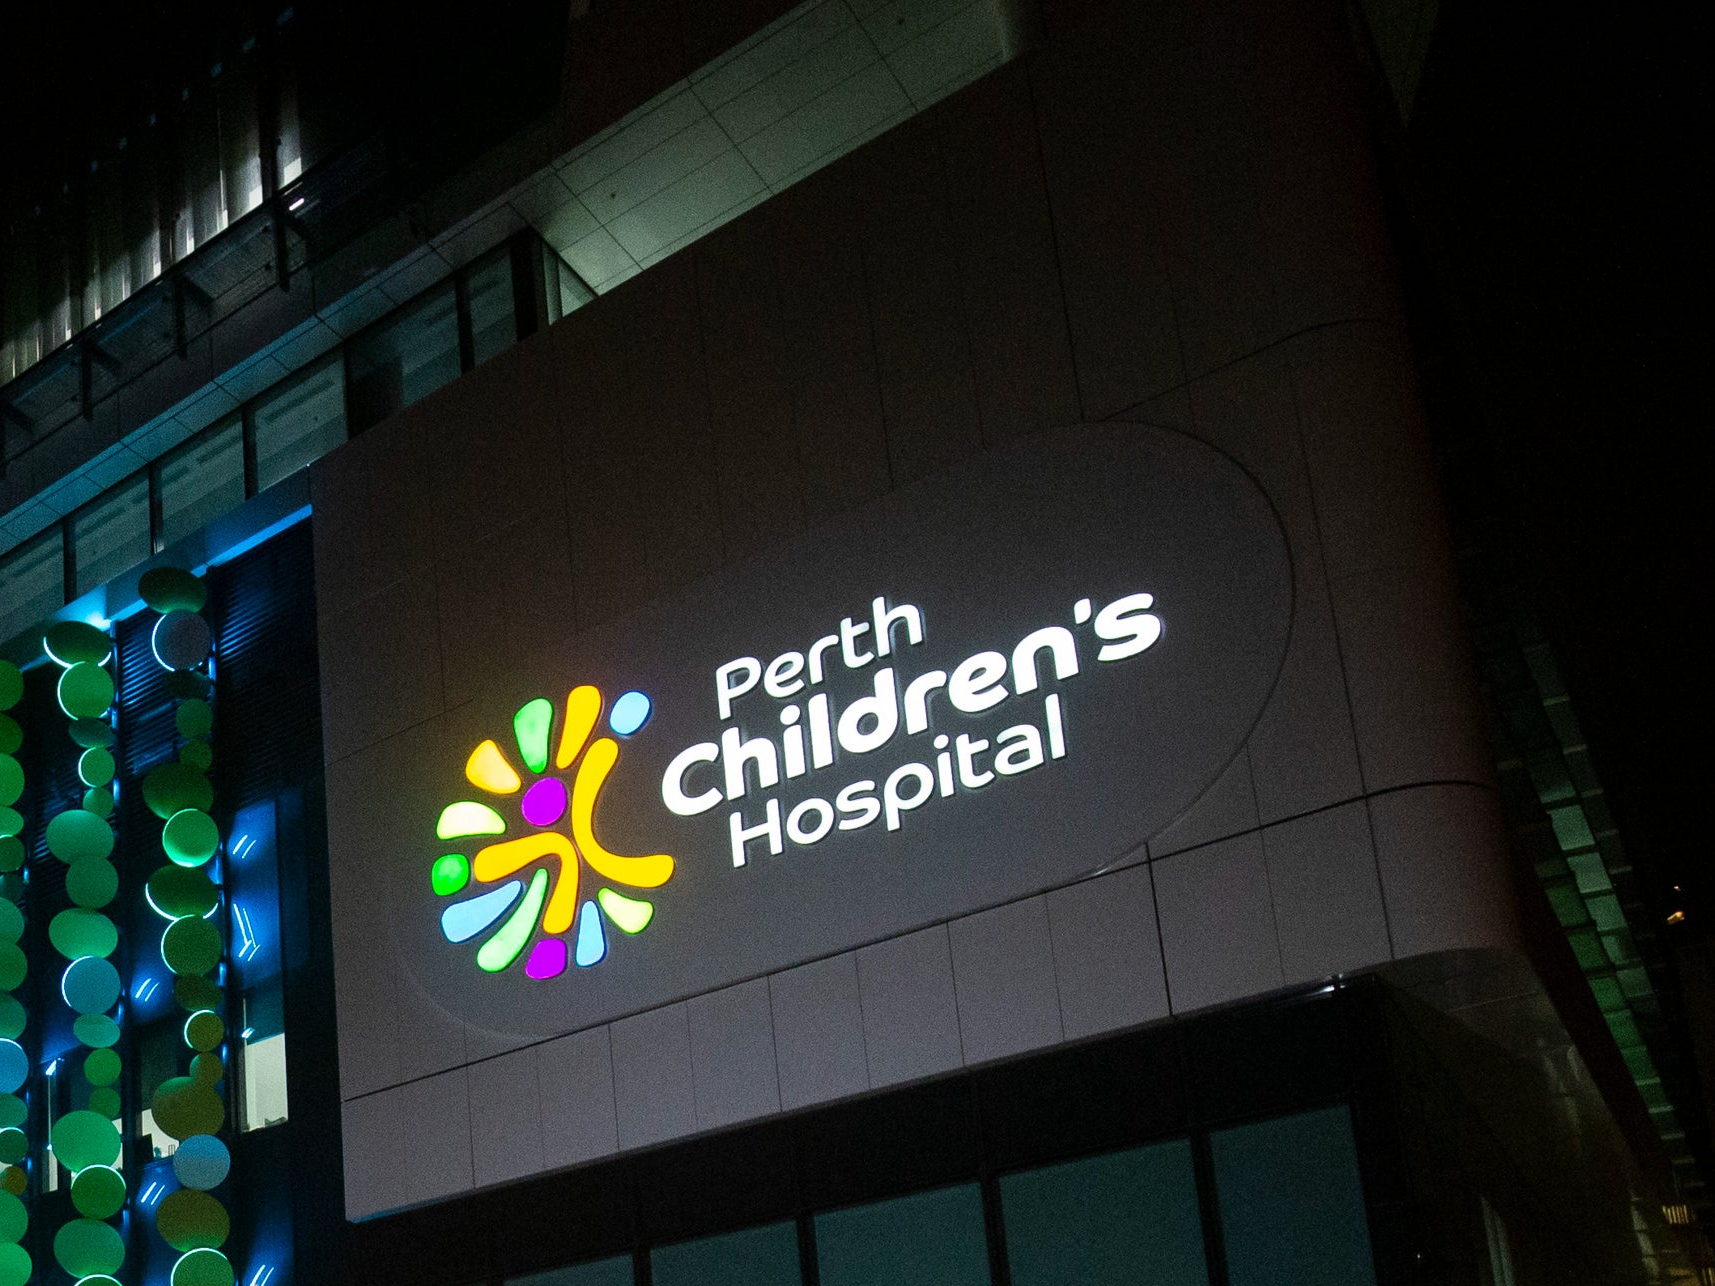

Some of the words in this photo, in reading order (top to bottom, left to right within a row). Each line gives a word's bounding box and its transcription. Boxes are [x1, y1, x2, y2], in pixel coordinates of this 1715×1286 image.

[661, 592, 1163, 815] Children's
[715, 596, 924, 719] Perth
[727, 694, 1068, 868] Hospital
